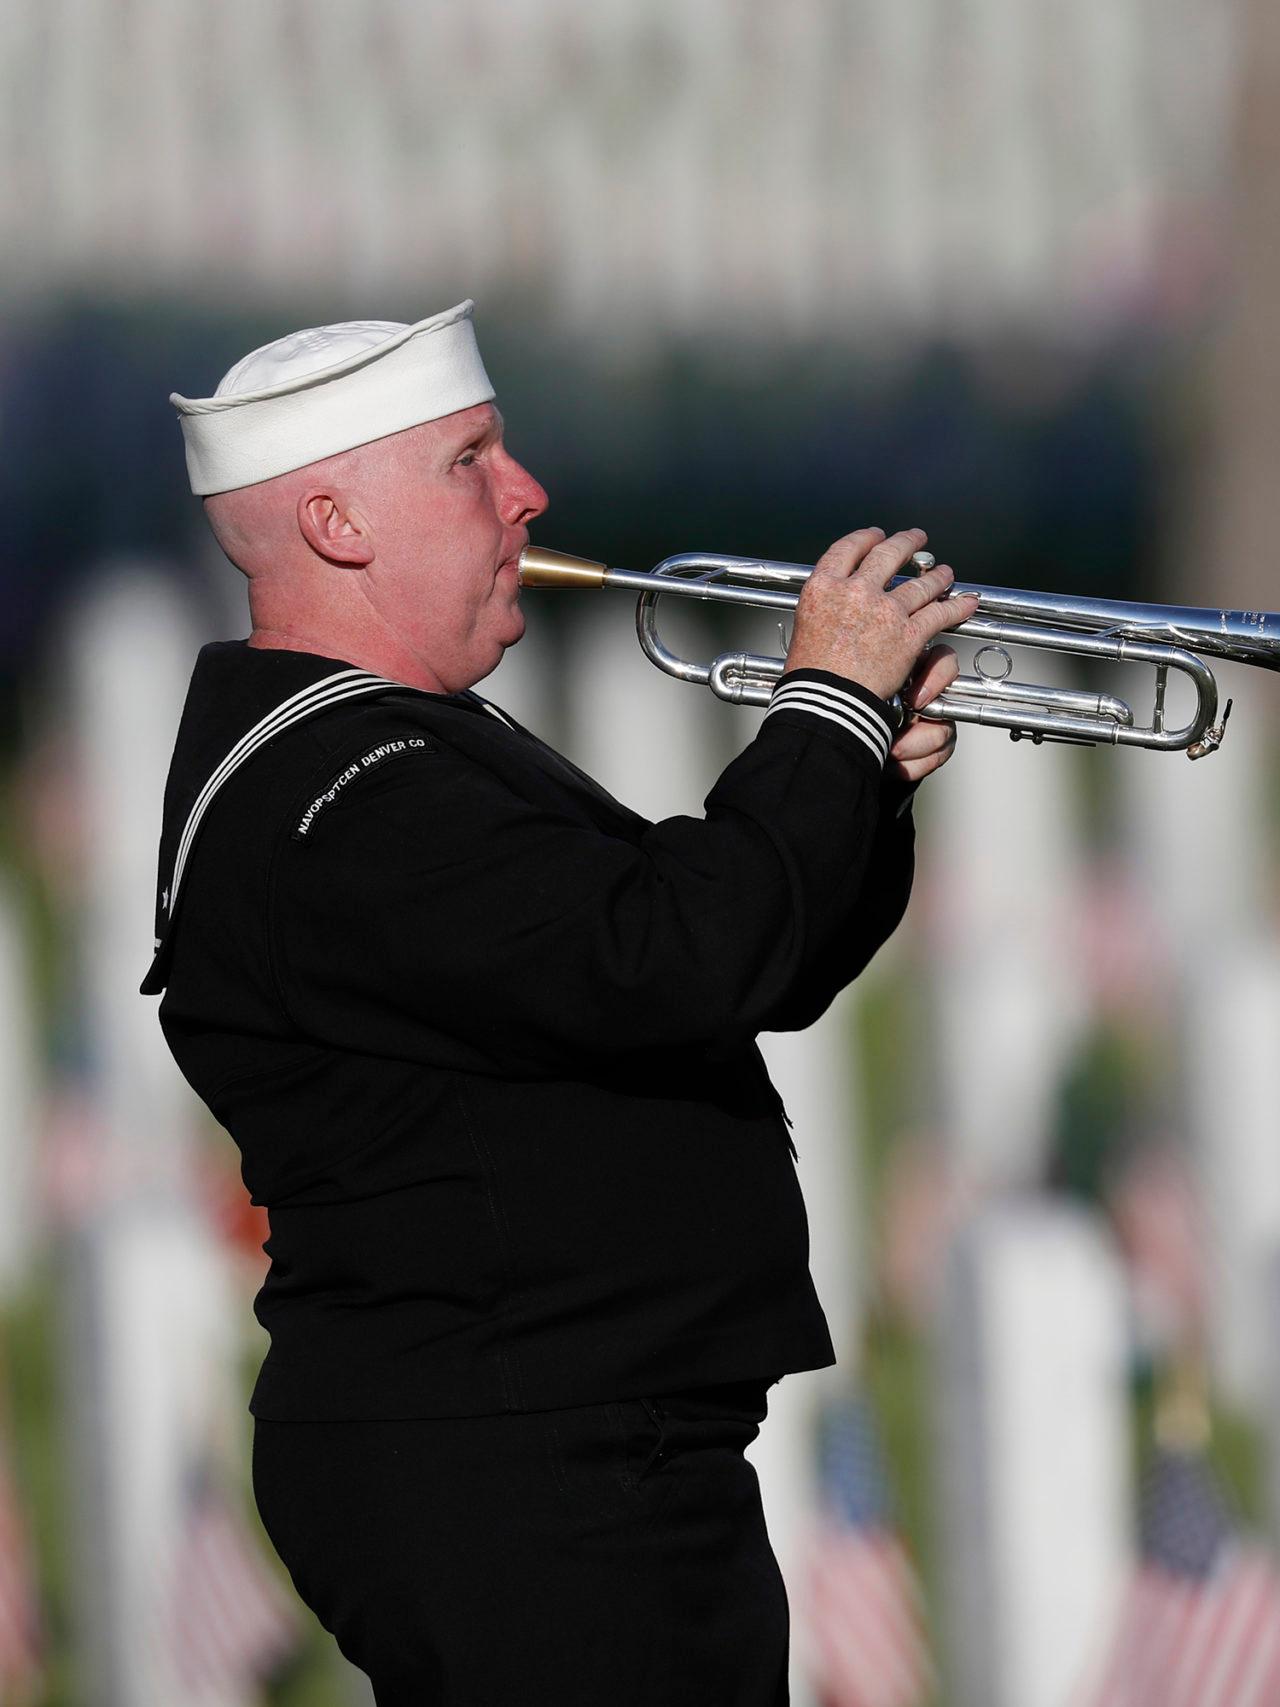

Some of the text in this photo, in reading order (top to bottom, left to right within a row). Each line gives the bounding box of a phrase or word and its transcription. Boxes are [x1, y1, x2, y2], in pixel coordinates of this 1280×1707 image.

[298, 739, 425, 834] NAVOPSPTCEN DENVER CO
